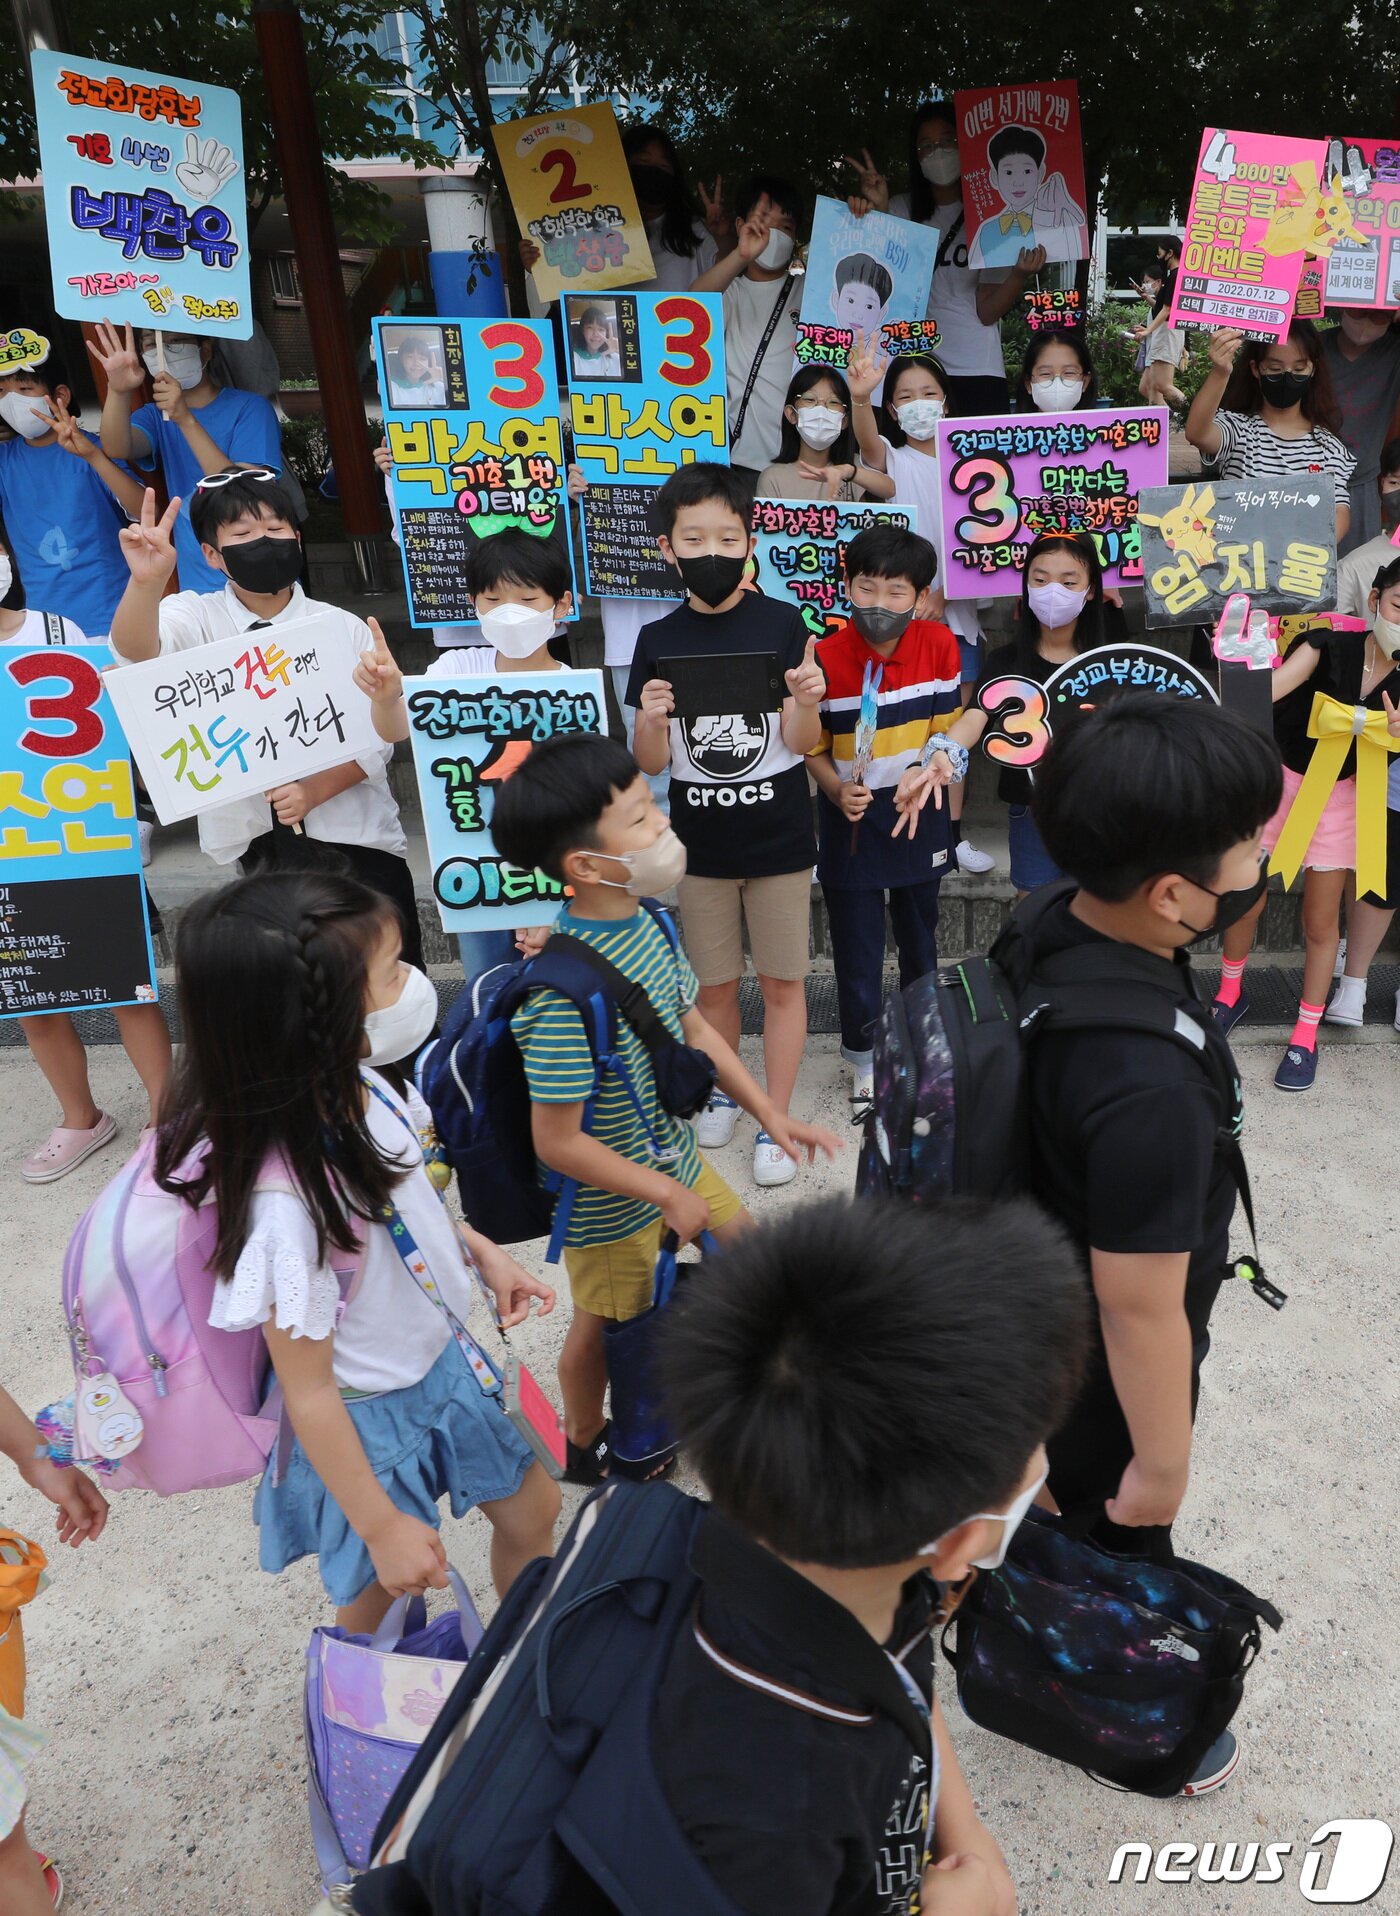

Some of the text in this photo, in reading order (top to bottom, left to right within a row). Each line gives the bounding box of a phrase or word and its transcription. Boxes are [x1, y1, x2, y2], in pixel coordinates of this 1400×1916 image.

[964, 90, 1070, 138] 이번 선거엔 2번
[67, 133, 170, 173] 기호 4번
[540, 149, 593, 203] 2
[1194, 180, 1279, 219] 볼트급
[70, 186, 239, 267] 백찬유
[543, 207, 624, 239] 행복한 학교
[1190, 213, 1247, 247] 공약
[1185, 243, 1266, 283] 이벤트
[1331, 256, 1376, 272] 급식으로
[1024, 290, 1079, 309] 기호3번
[1182, 277, 1276, 301] 일시 2022.07.12
[1329, 275, 1375, 291] 세계여행
[1180, 296, 1280, 323] 선택 기호4번 엄지율
[621, 300, 638, 370] 회장 후보
[654, 296, 713, 388] 3
[798, 324, 852, 349] 기호3번
[883, 320, 936, 337] 기호3번
[887, 334, 932, 355] 송지효
[445, 327, 466, 404] 회장 후보
[480, 322, 546, 409] 3
[797, 338, 849, 368] 송지효
[952, 419, 1159, 457] 전교부회장후보 기호3번
[453, 455, 555, 489] 기호1번
[1043, 462, 1126, 496] 말보다는
[457, 487, 552, 524] 이태윤
[953, 457, 1019, 545] 3
[1021, 497, 1086, 515] 기호3번
[1235, 491, 1265, 511] 찍어
[1026, 510, 1087, 535] 송지효
[954, 545, 1028, 573] 기호3번
[790, 582, 837, 607] 가장
[1214, 593, 1278, 669] 4
[8, 652, 104, 758] 3
[154, 667, 235, 719] 우리학교
[284, 693, 346, 748] 간다
[414, 691, 596, 742] 전교회장후보
[982, 679, 1050, 766] 3
[437, 763, 480, 829] 기호
[686, 781, 775, 808] crocs
[438, 861, 576, 905] 이태
